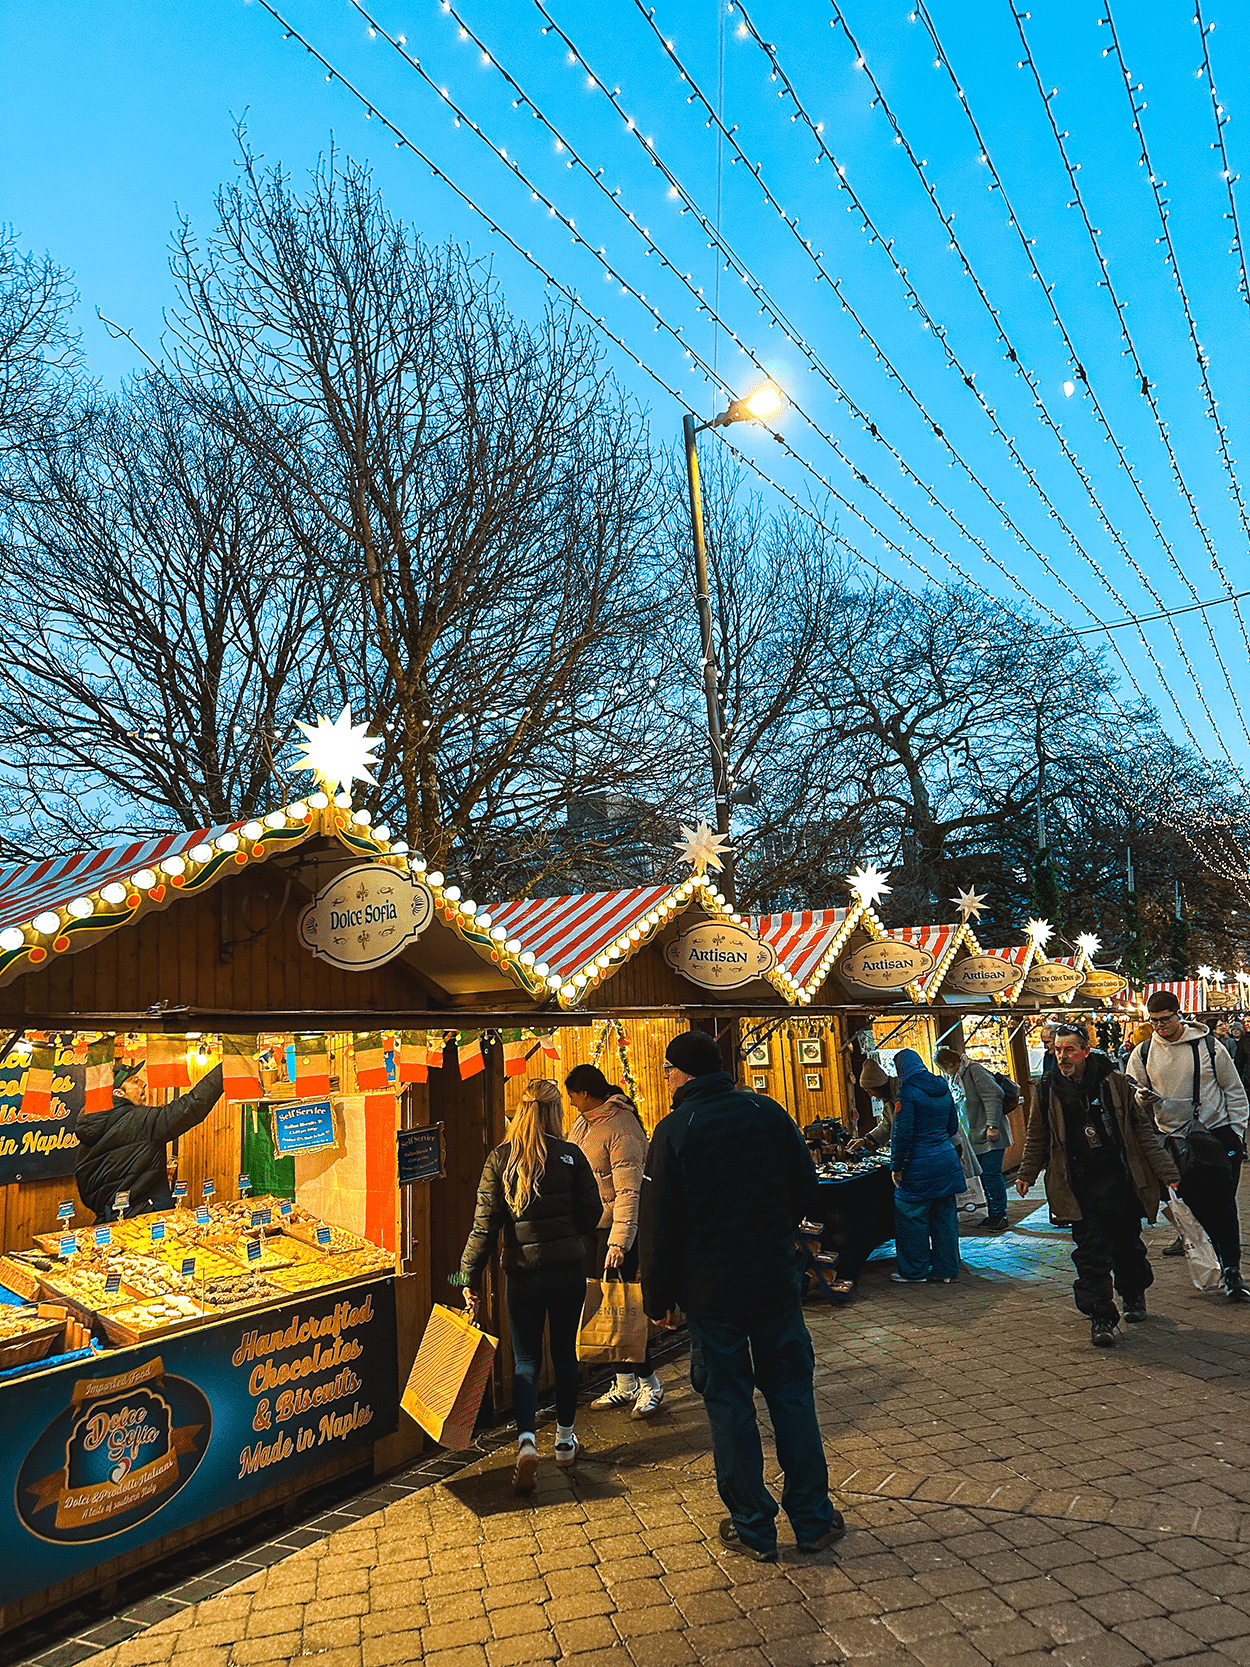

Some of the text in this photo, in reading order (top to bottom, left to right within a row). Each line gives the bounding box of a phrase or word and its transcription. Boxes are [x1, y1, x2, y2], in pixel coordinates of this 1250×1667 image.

[330, 899, 398, 931] Dolce Sofia
[688, 948, 748, 963] Artisan
[862, 959, 913, 971] Artisan
[279, 1106, 327, 1121] Self Service
[20, 1126, 80, 1155] Naples
[232, 1294, 375, 1367] Handcrafted
[85, 1365, 153, 1396] Imported Food
[249, 1336, 364, 1397] Chocolates
[252, 1366, 363, 1432] & Biscuits
[83, 1406, 148, 1451] Dolce
[107, 1425, 160, 1461] Sofia
[238, 1401, 374, 1480] Made in Naples
[64, 1493, 91, 1509] Dolci
